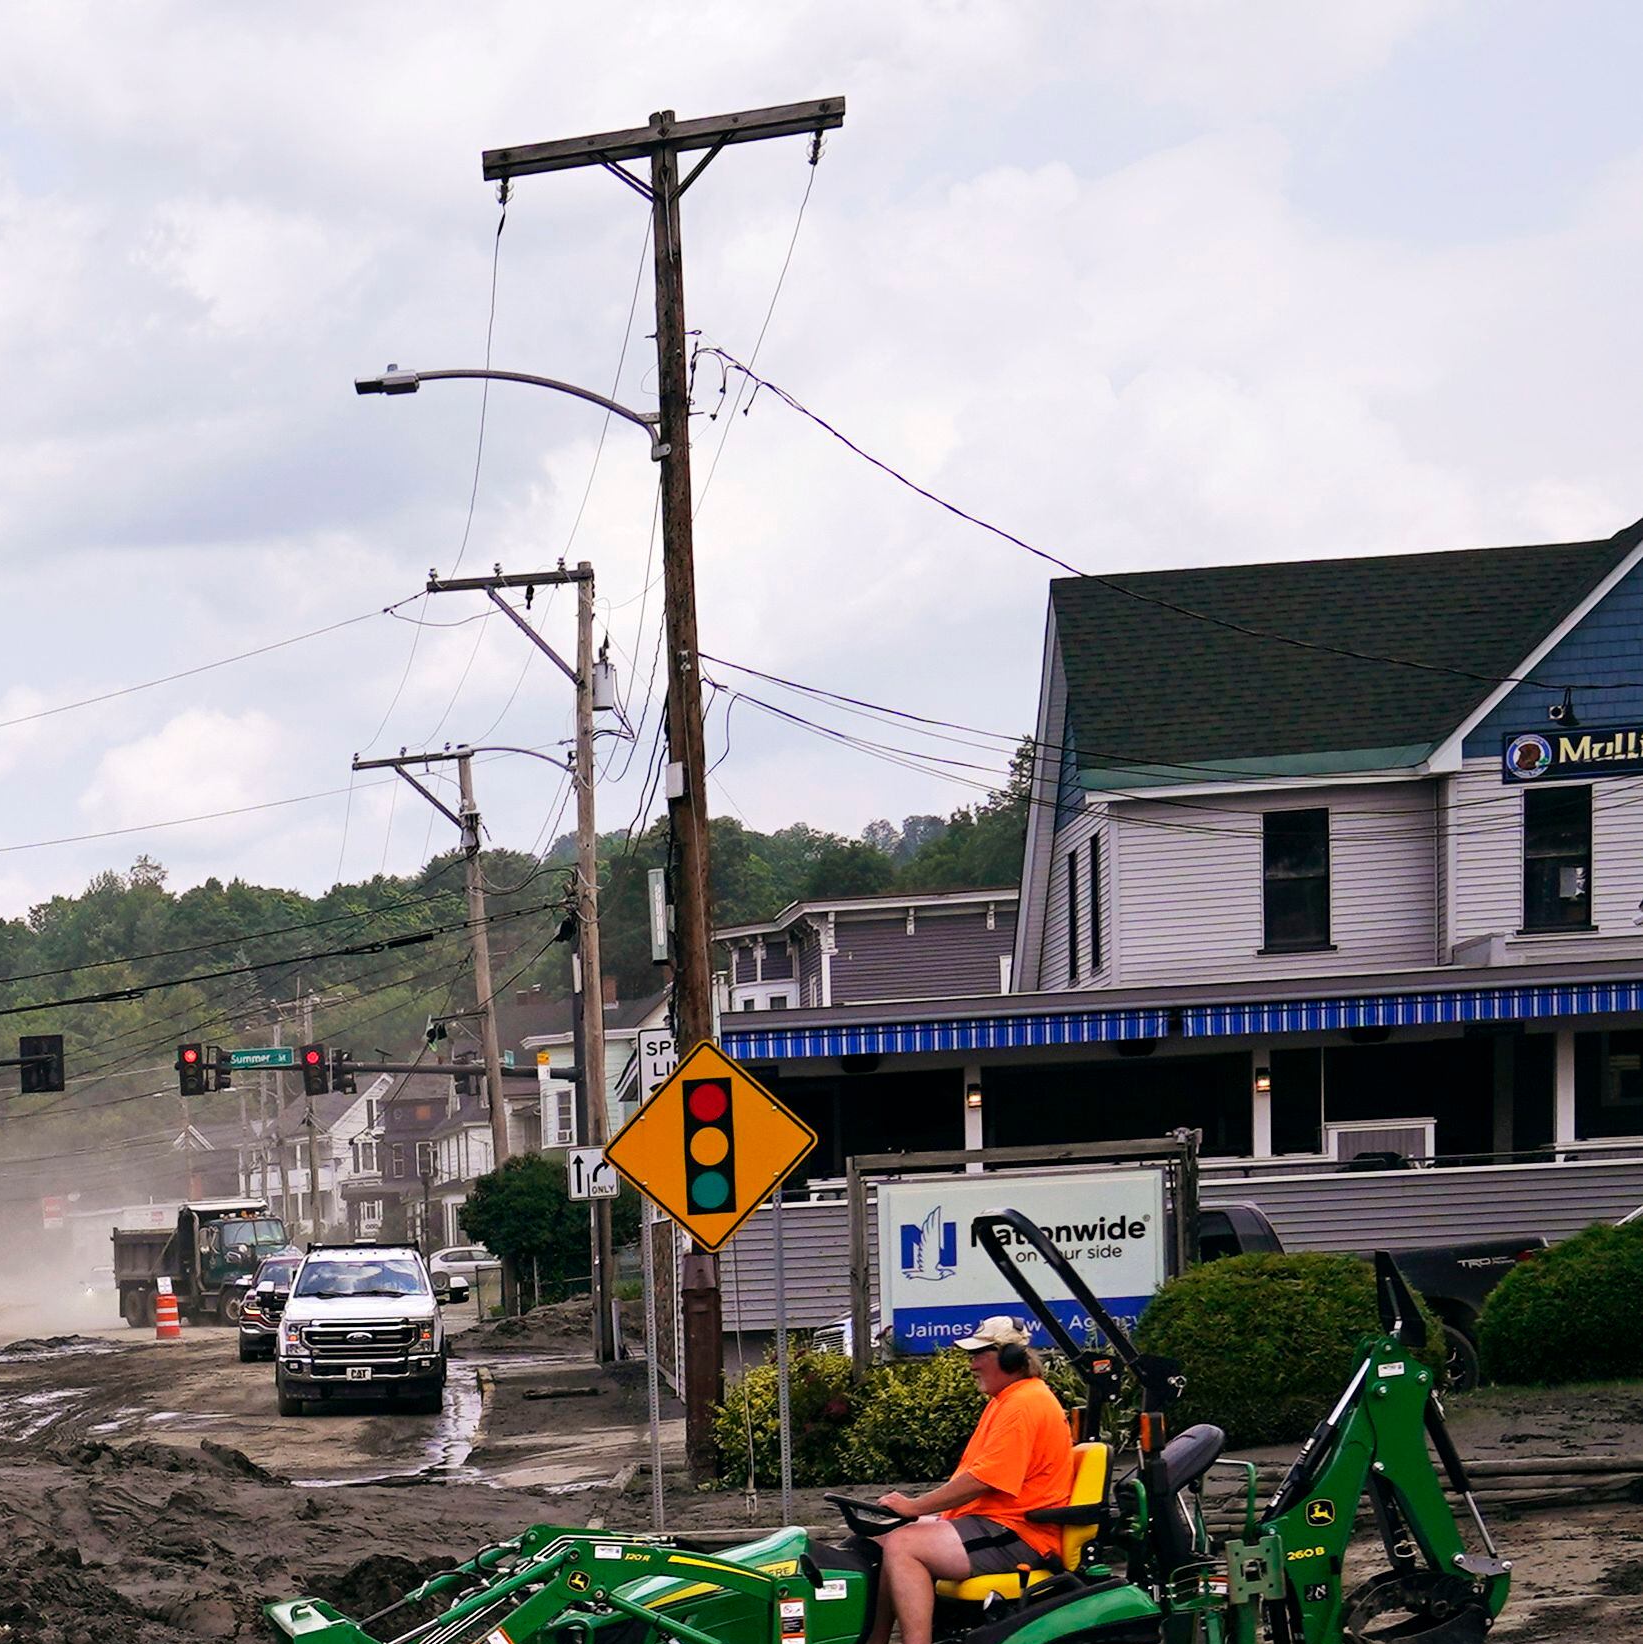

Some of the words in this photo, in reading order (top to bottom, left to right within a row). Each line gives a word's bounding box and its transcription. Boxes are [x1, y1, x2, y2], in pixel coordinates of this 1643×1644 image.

[230, 1054, 270, 1064] Summer
[592, 1185, 614, 1194] ONLY
[1016, 1252, 1037, 1263] on
[1088, 1244, 1123, 1260] side
[1457, 1258, 1491, 1269] TRD
[905, 1323, 973, 1338] Jaimes
[351, 1369, 369, 1379] CAT
